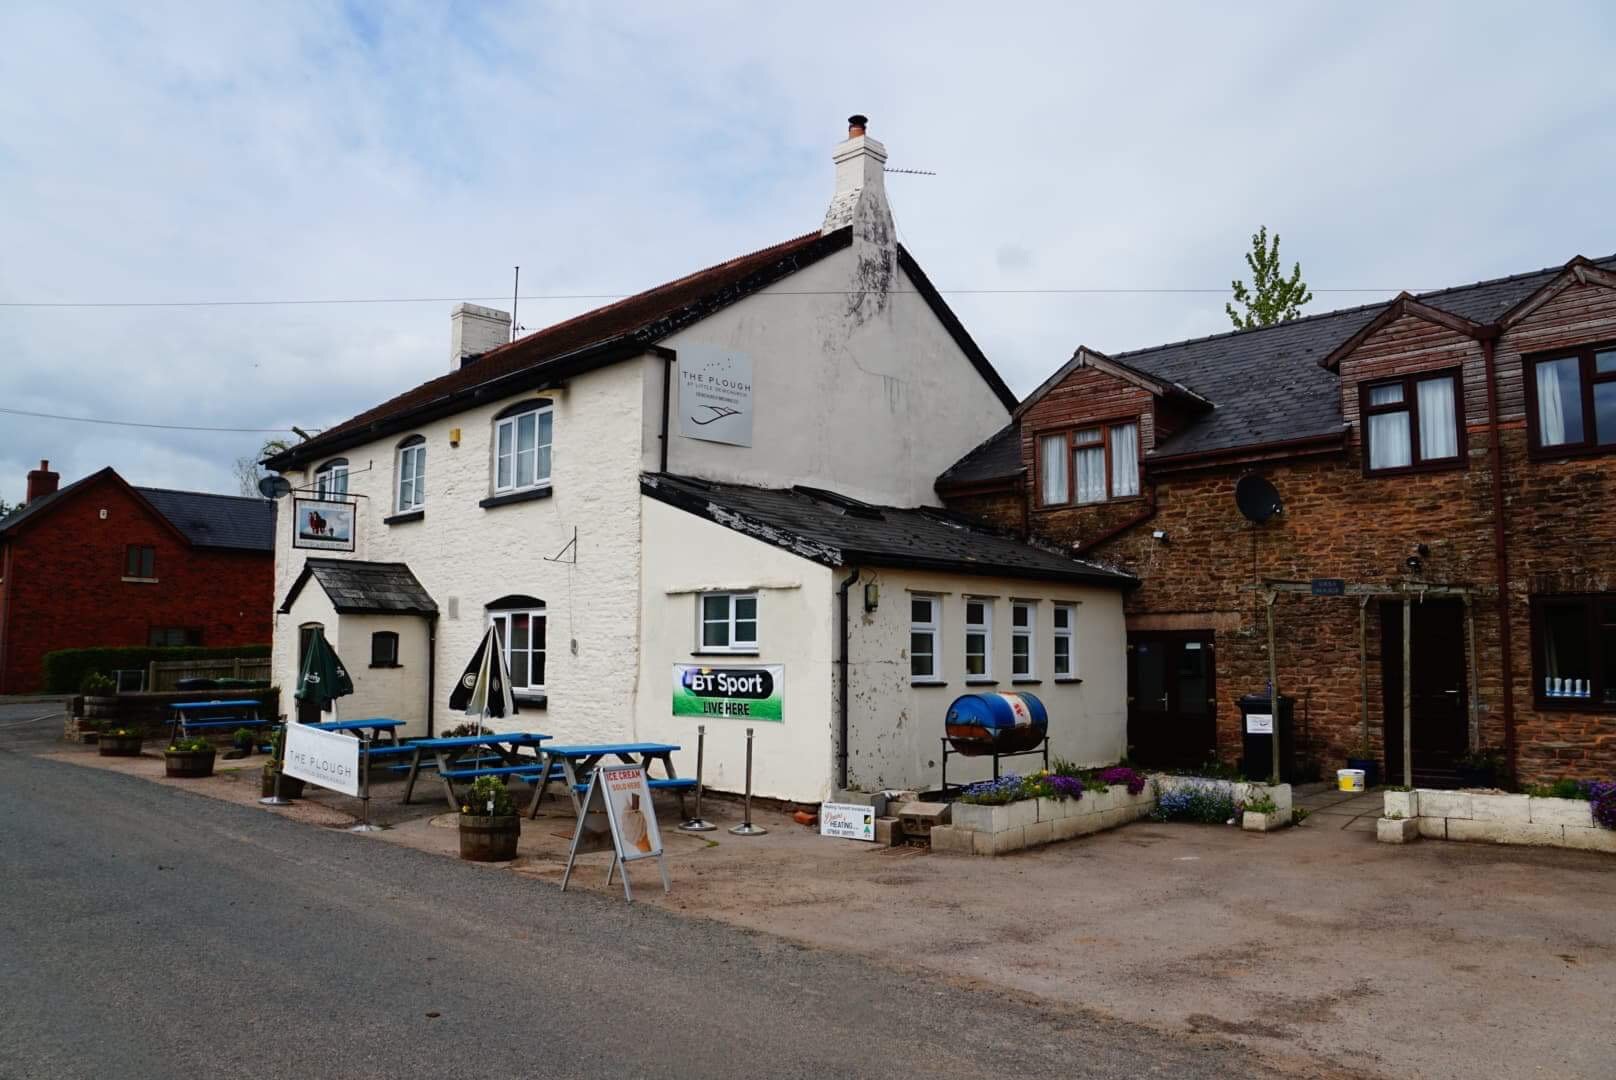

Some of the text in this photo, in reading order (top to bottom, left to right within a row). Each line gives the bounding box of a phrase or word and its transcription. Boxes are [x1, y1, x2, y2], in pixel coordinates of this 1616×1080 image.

[682, 371, 752, 392] THE PLOUGH
[692, 673, 762, 696] BT Sport
[703, 701, 750, 716] LIVE HERE
[289, 750, 306, 765] THE
[310, 756, 352, 777] PLOUGH
[606, 769, 641, 781] ICE CREAM
